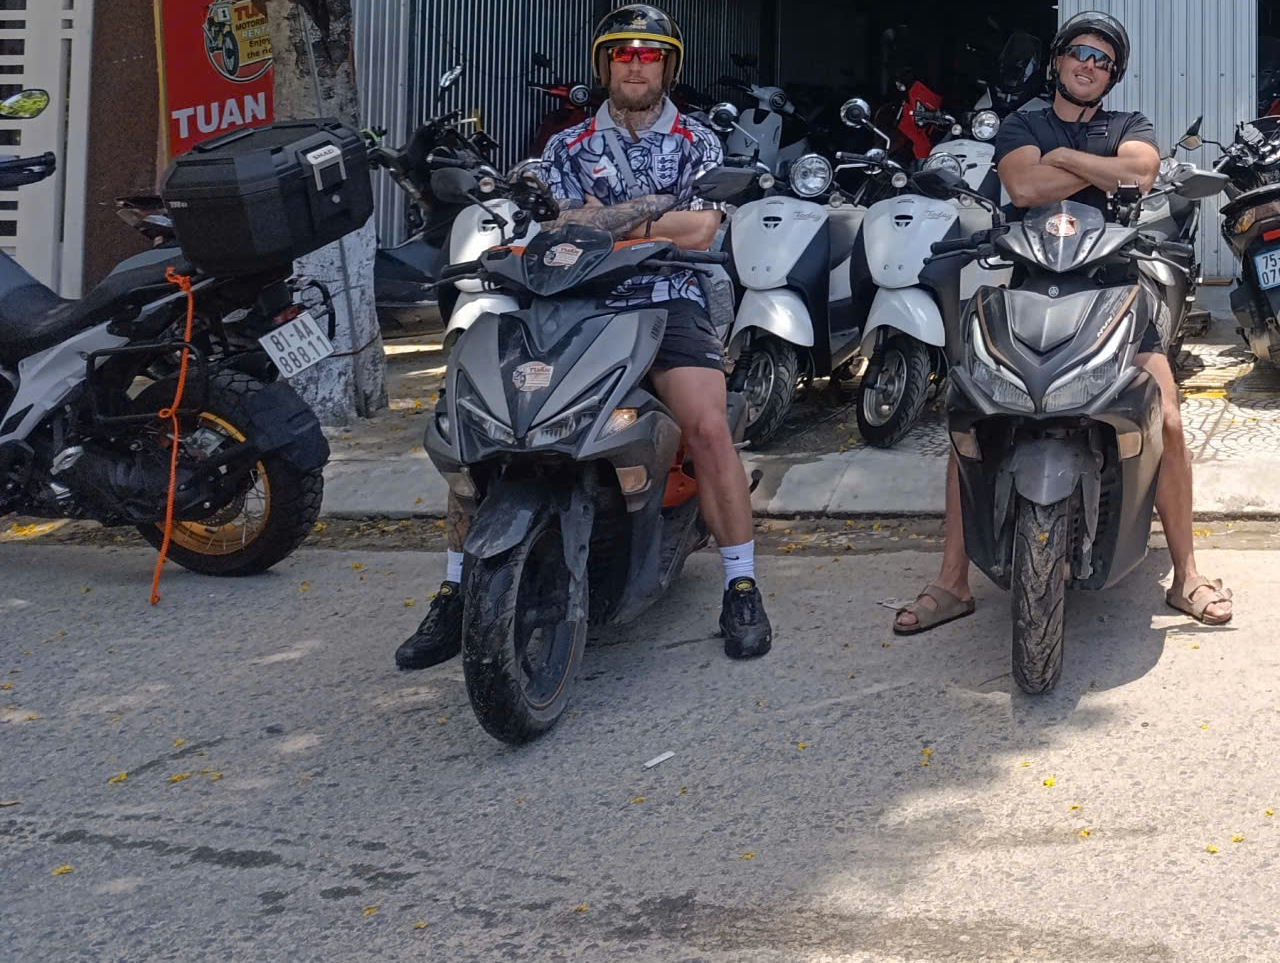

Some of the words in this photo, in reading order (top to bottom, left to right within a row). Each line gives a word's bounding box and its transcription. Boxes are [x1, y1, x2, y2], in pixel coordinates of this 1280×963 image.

[247, 50, 260, 59] the
[172, 92, 266, 139] TUAN
[270, 319, 314, 352] 81-AA
[279, 335, 330, 373] 888.11
